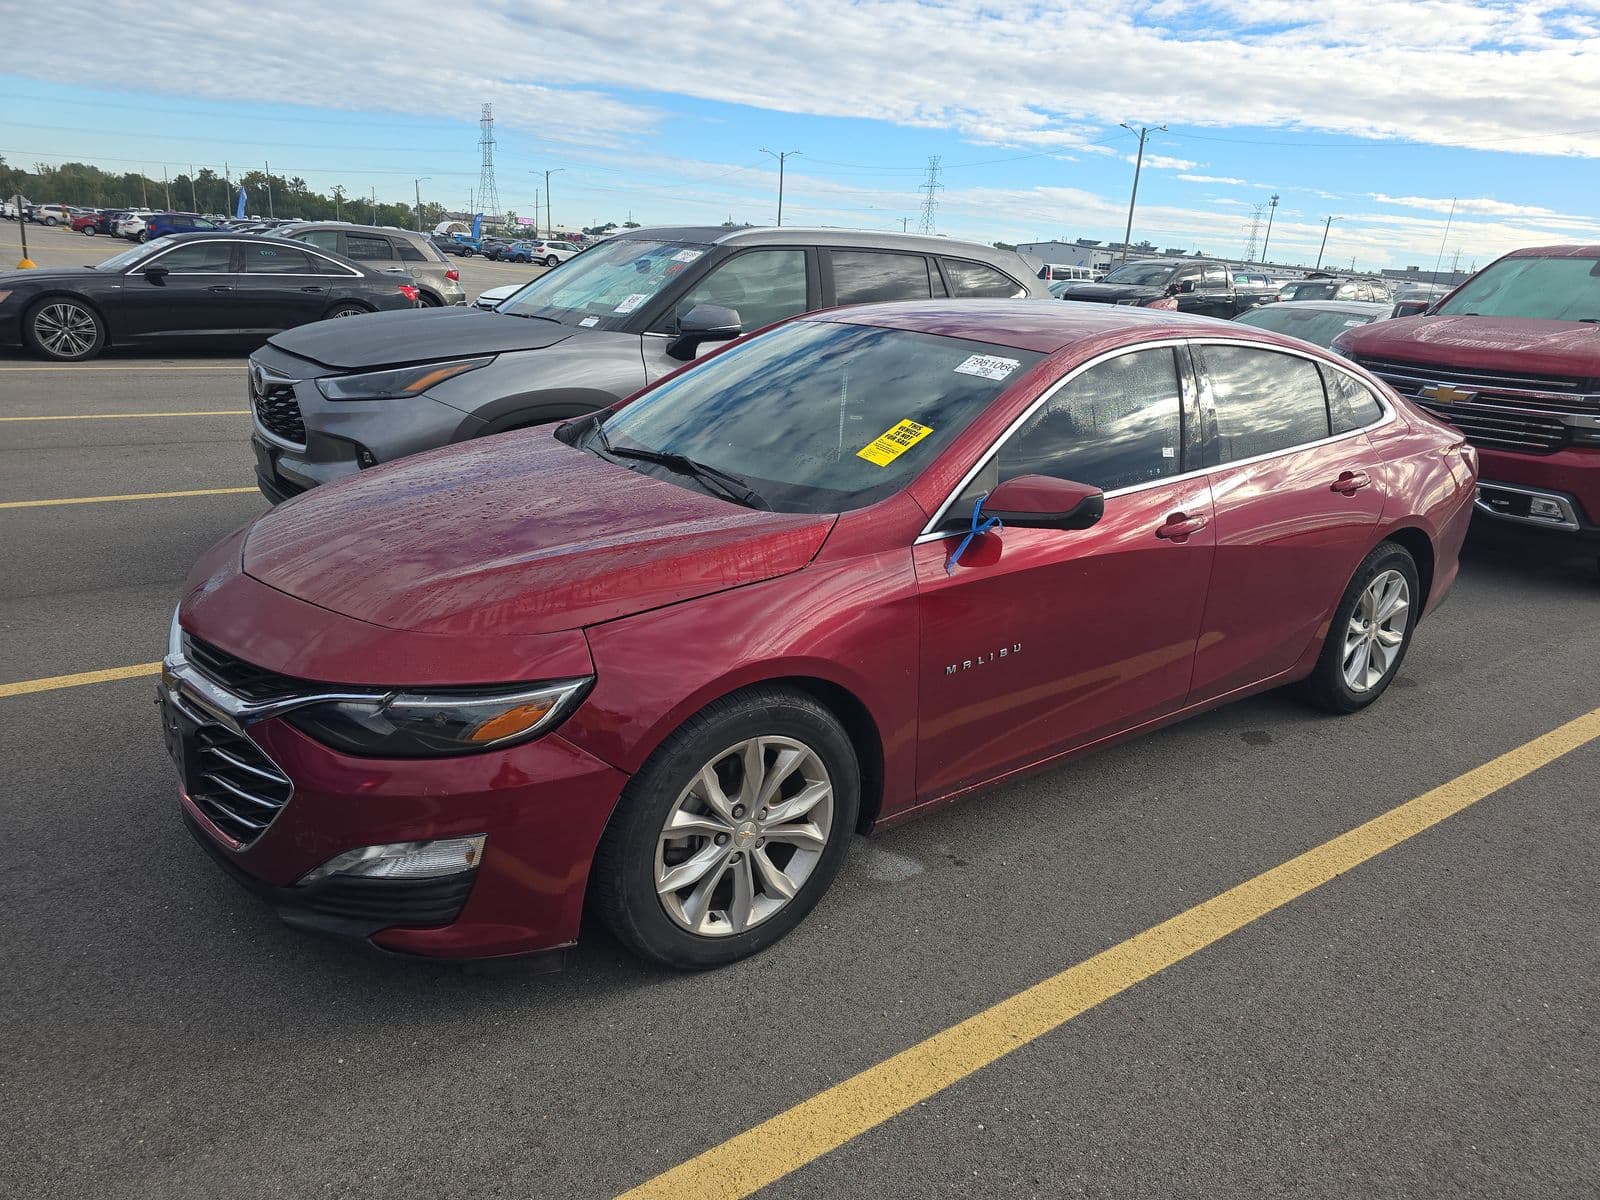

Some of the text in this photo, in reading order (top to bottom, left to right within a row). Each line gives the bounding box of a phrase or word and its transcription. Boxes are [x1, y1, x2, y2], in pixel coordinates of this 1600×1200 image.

[908, 422, 923, 430] THIS
[898, 426, 922, 437] VEHICLE
[895, 438, 910, 447] SALE
[946, 643, 1021, 675] MALIBU
